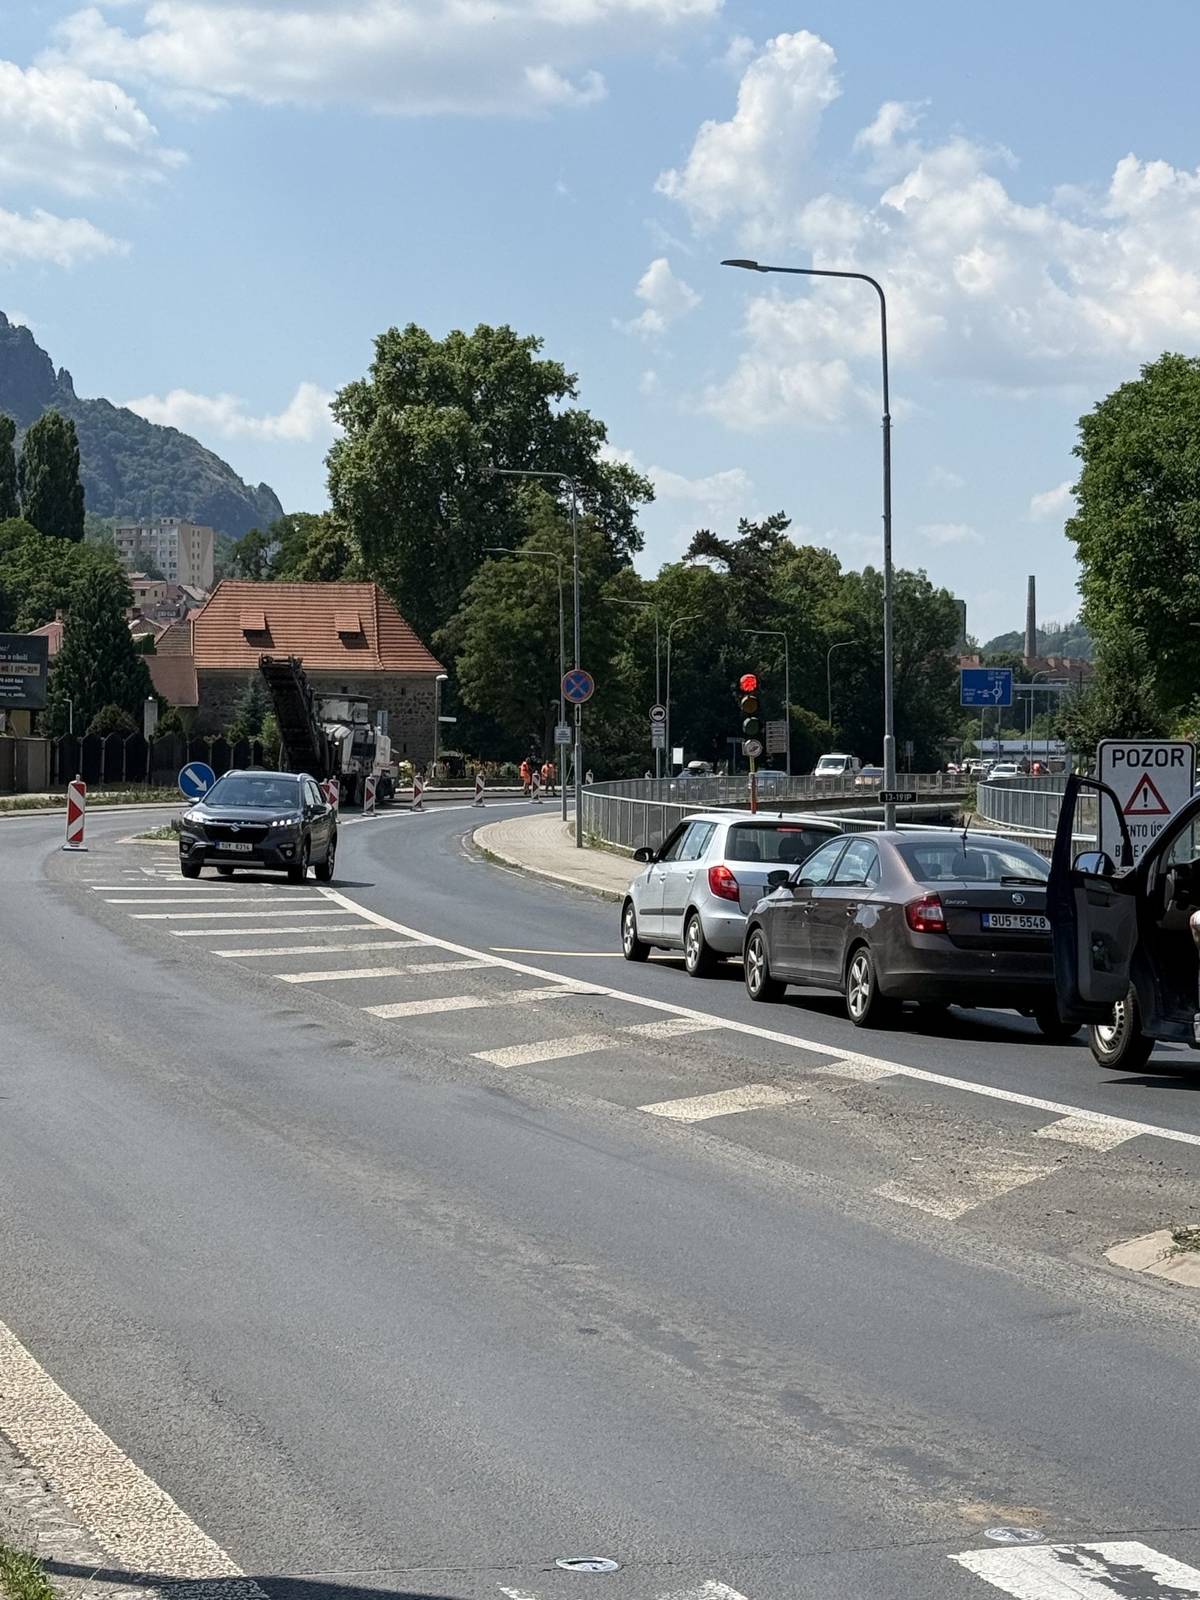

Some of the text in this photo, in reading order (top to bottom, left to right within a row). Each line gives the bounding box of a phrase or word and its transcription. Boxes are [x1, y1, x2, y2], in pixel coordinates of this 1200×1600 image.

[1112, 748, 1185, 768] POZOR
[1121, 820, 1164, 837] NTO ÚS
[1115, 844, 1139, 857] BE
[991, 915, 1046, 929] 9U5 5548
